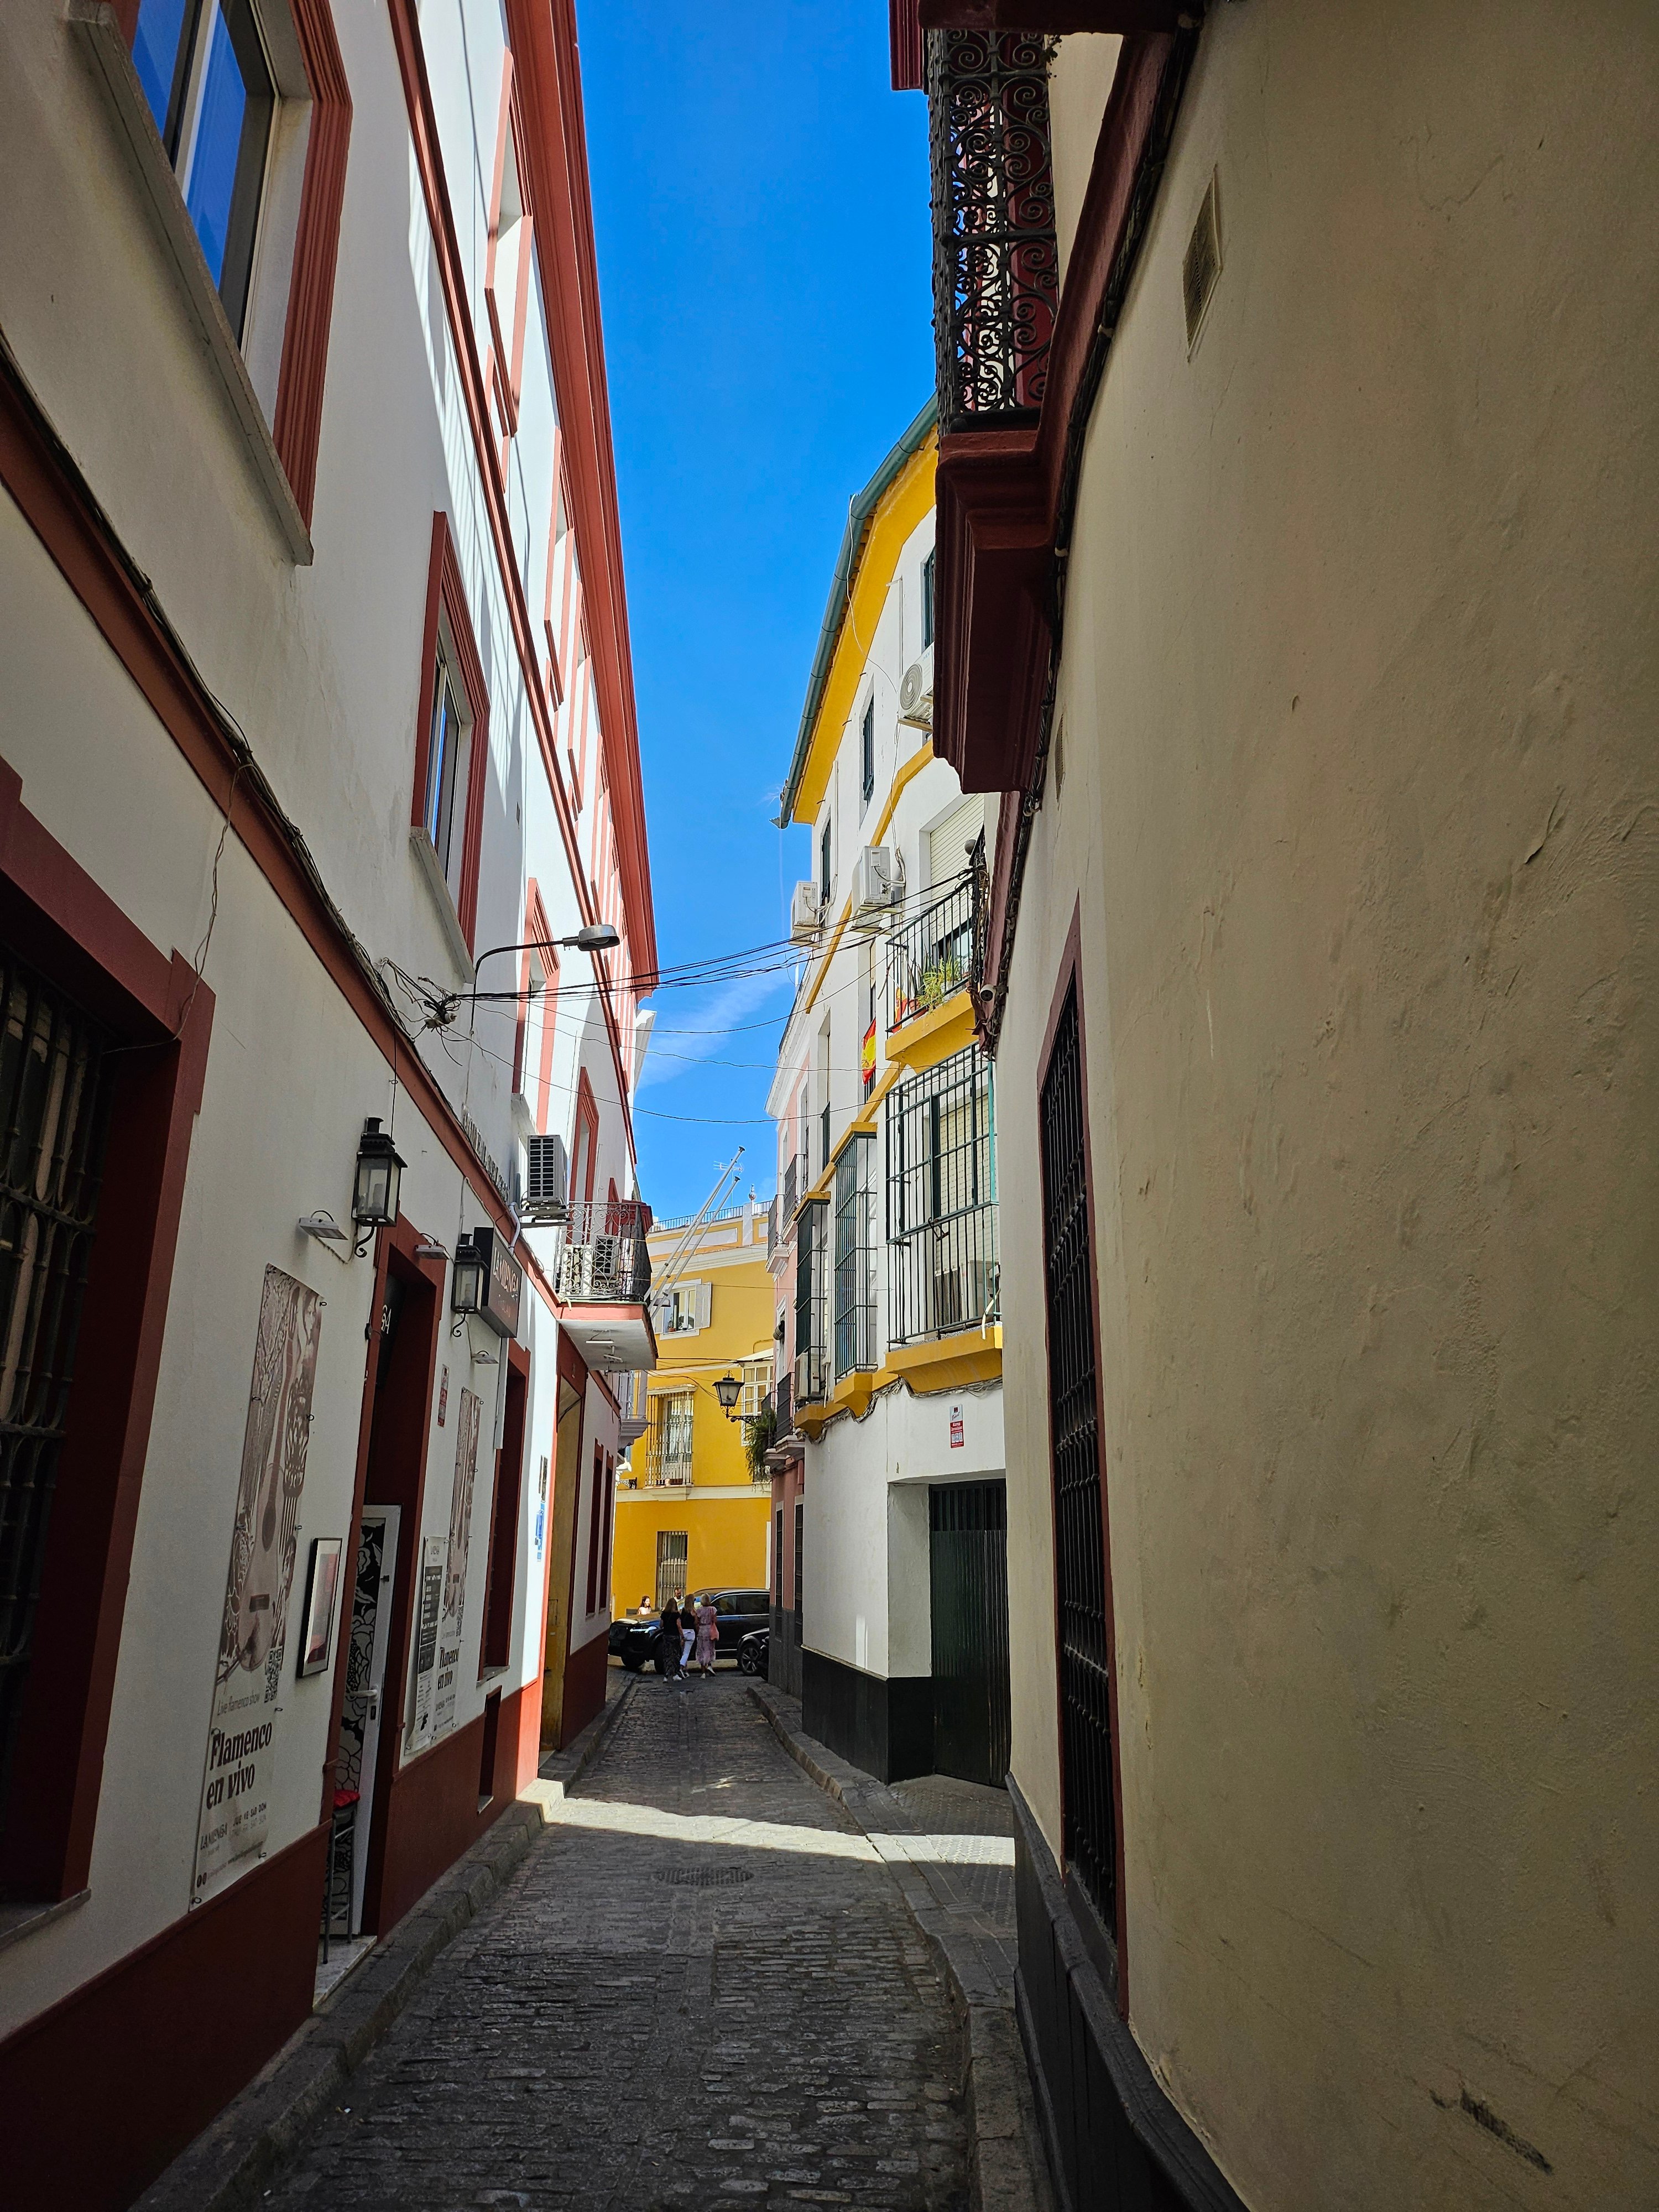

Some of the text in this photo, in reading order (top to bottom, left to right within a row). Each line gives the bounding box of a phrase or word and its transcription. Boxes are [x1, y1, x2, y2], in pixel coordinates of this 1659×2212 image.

[210, 1721, 273, 1771] Flamenco
[206, 1760, 255, 1810] en vivo
